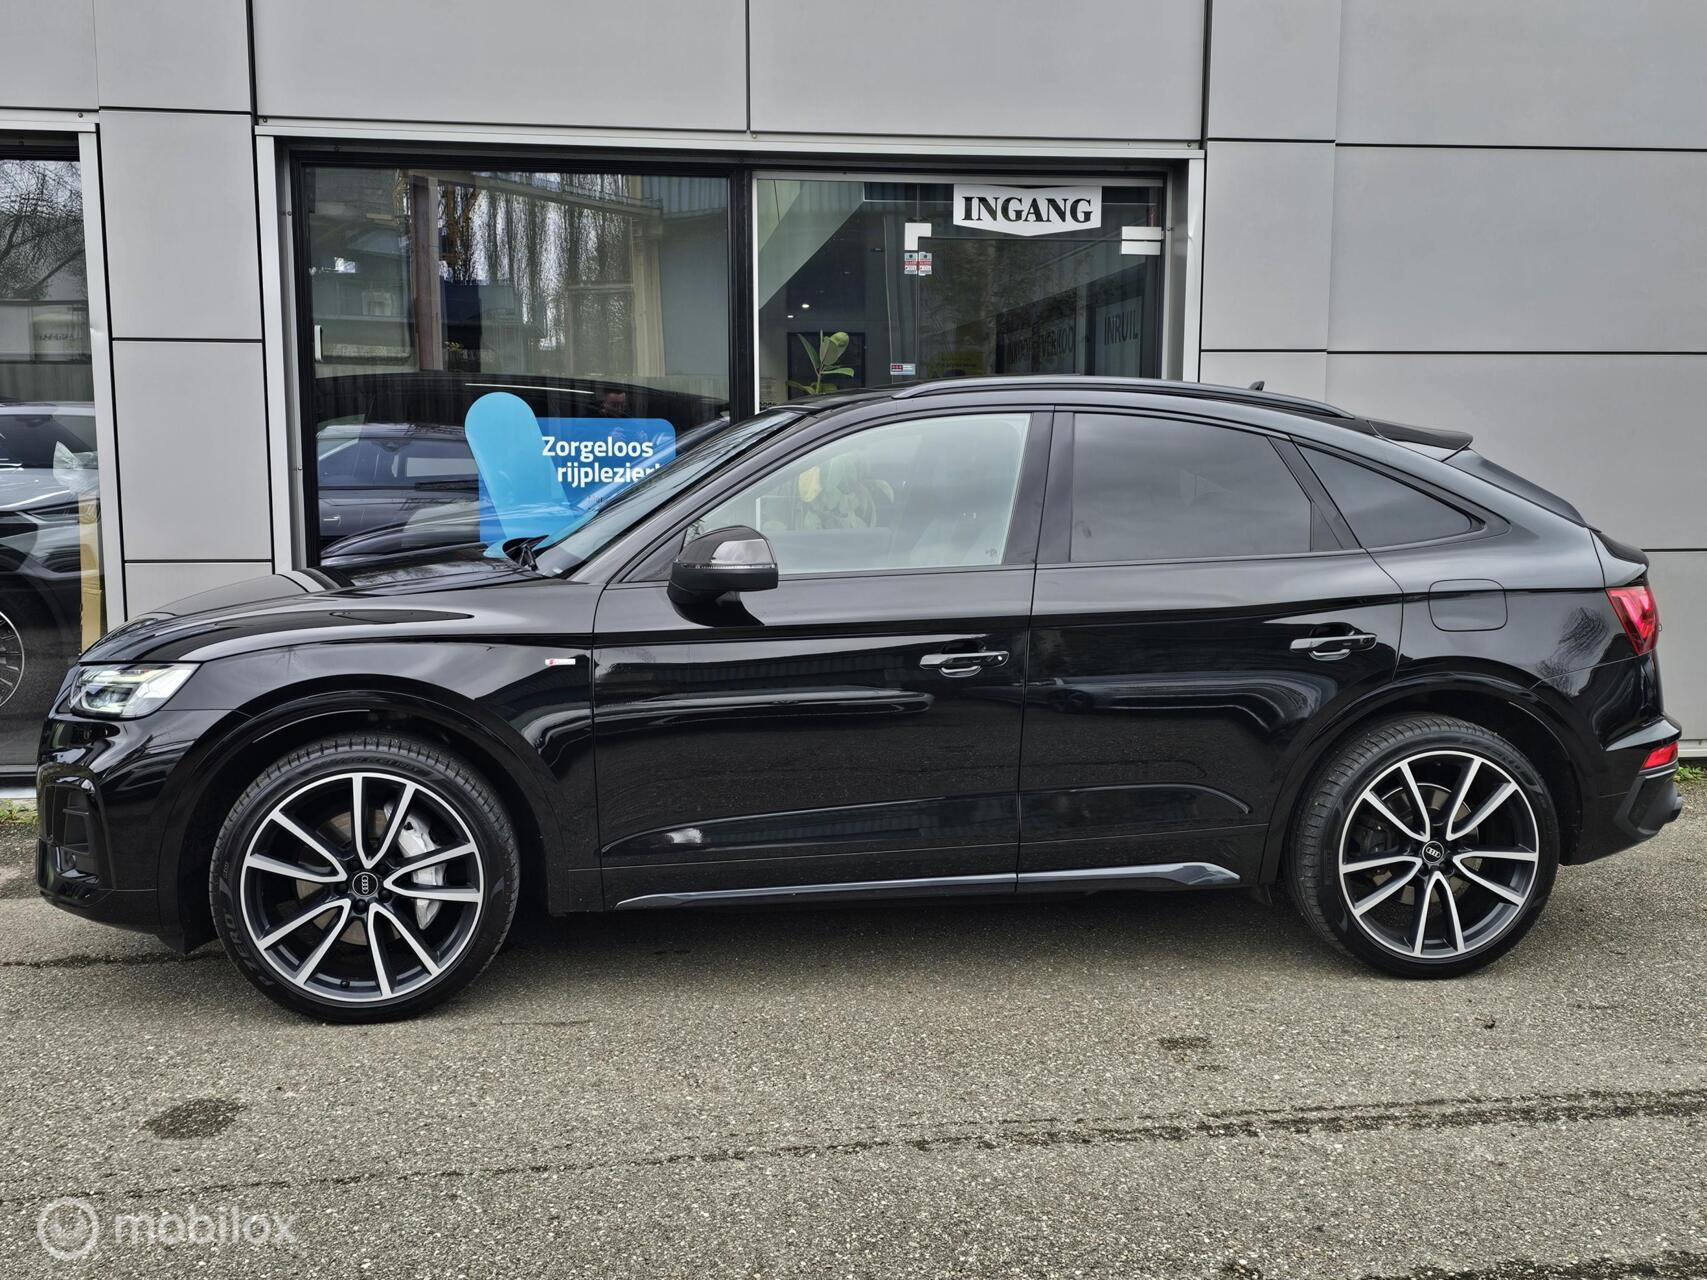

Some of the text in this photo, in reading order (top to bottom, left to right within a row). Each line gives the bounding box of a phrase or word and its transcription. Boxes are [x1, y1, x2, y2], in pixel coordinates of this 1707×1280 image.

[962, 196, 1093, 223] INGANG
[1104, 310, 1139, 345] INRUIL
[541, 436, 654, 462] Zorgeloos
[557, 462, 661, 488] rijplezier
